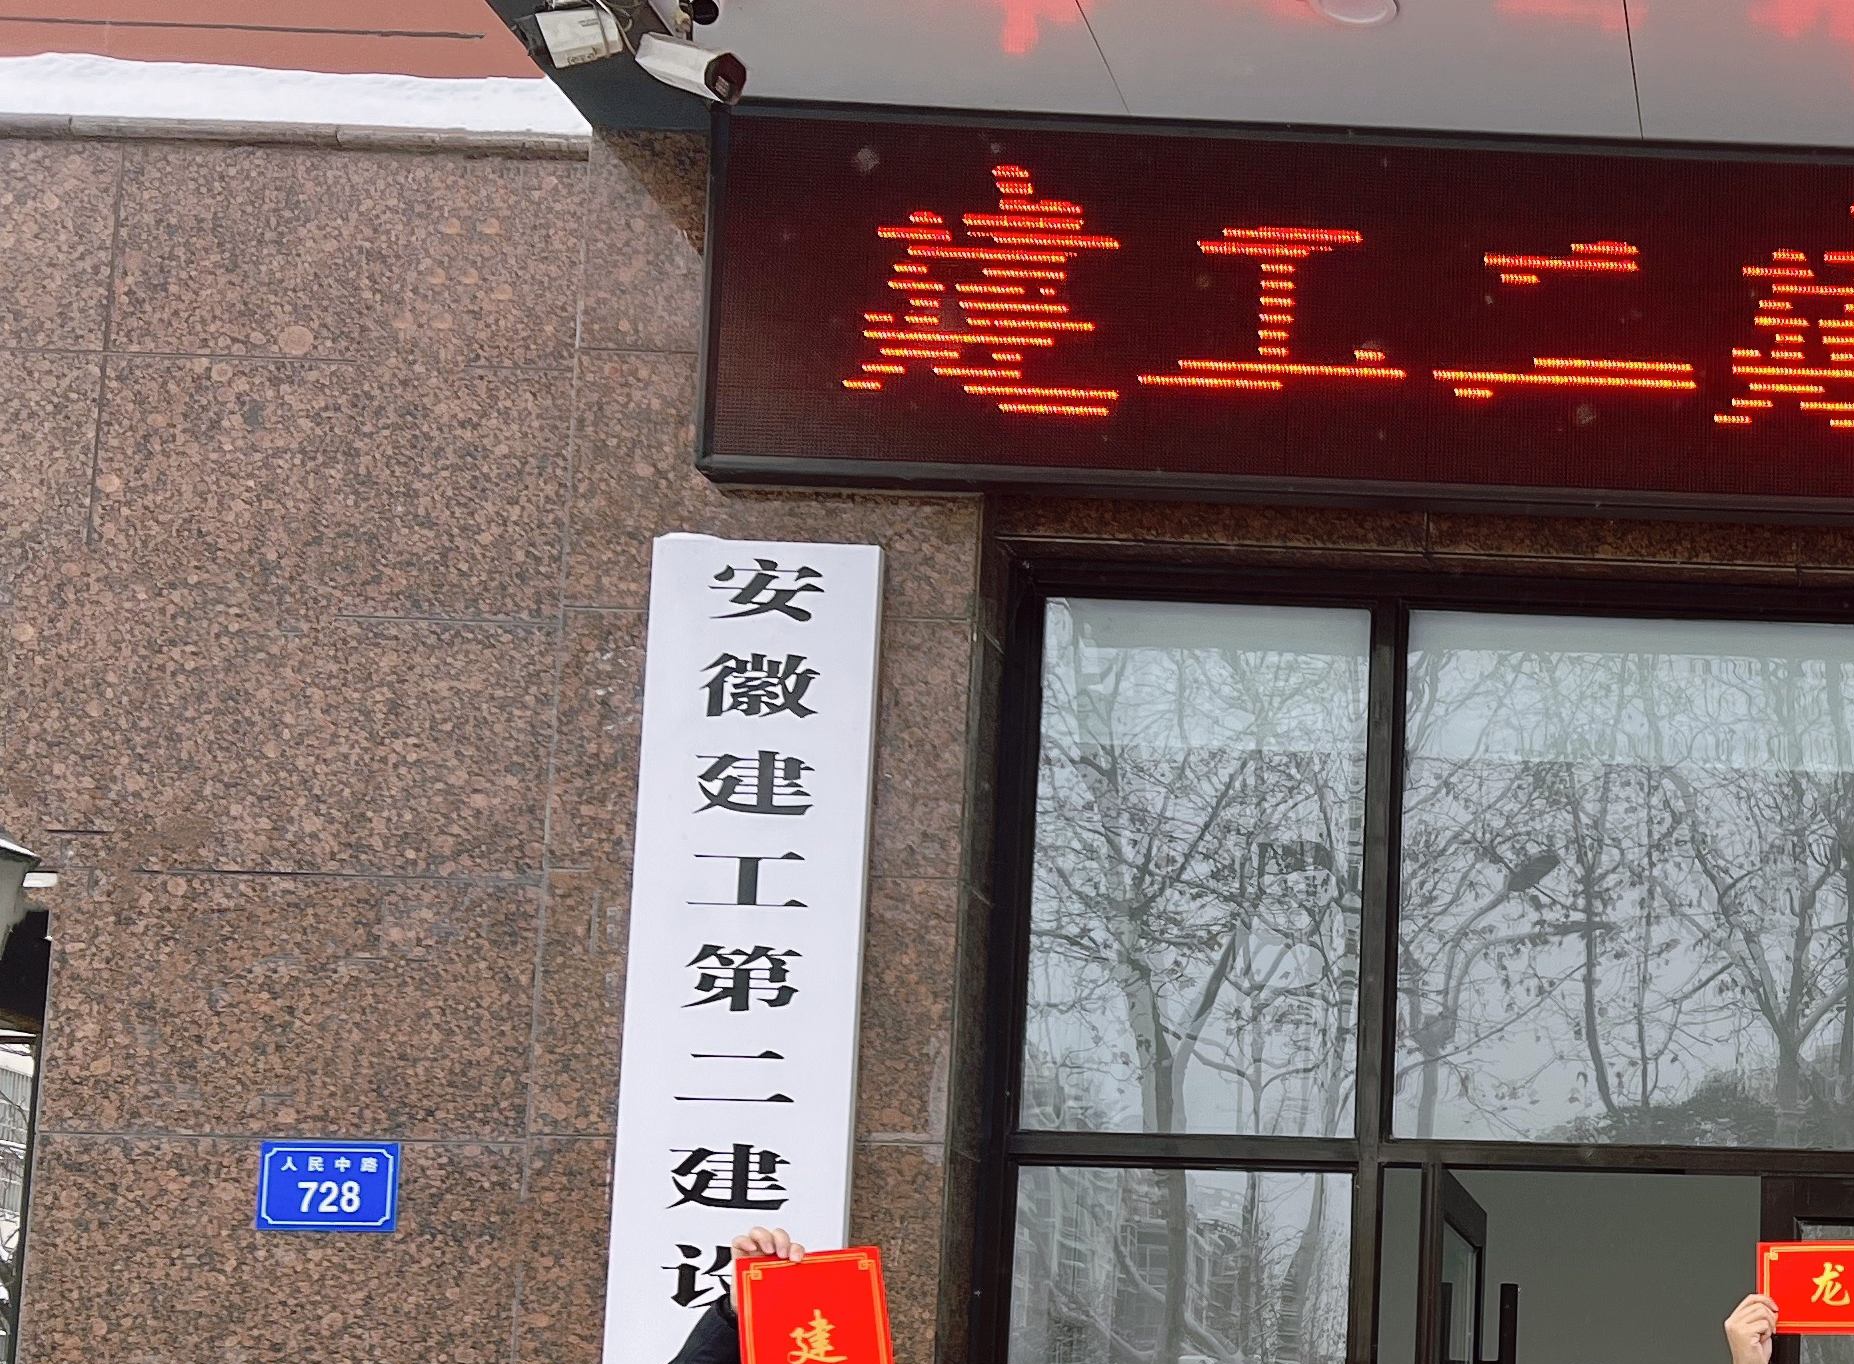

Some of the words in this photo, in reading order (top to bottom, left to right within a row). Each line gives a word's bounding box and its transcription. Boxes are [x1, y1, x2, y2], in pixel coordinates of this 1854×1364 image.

[281, 1156, 379, 1173] 人民中路
[298, 1180, 361, 1213] 728
